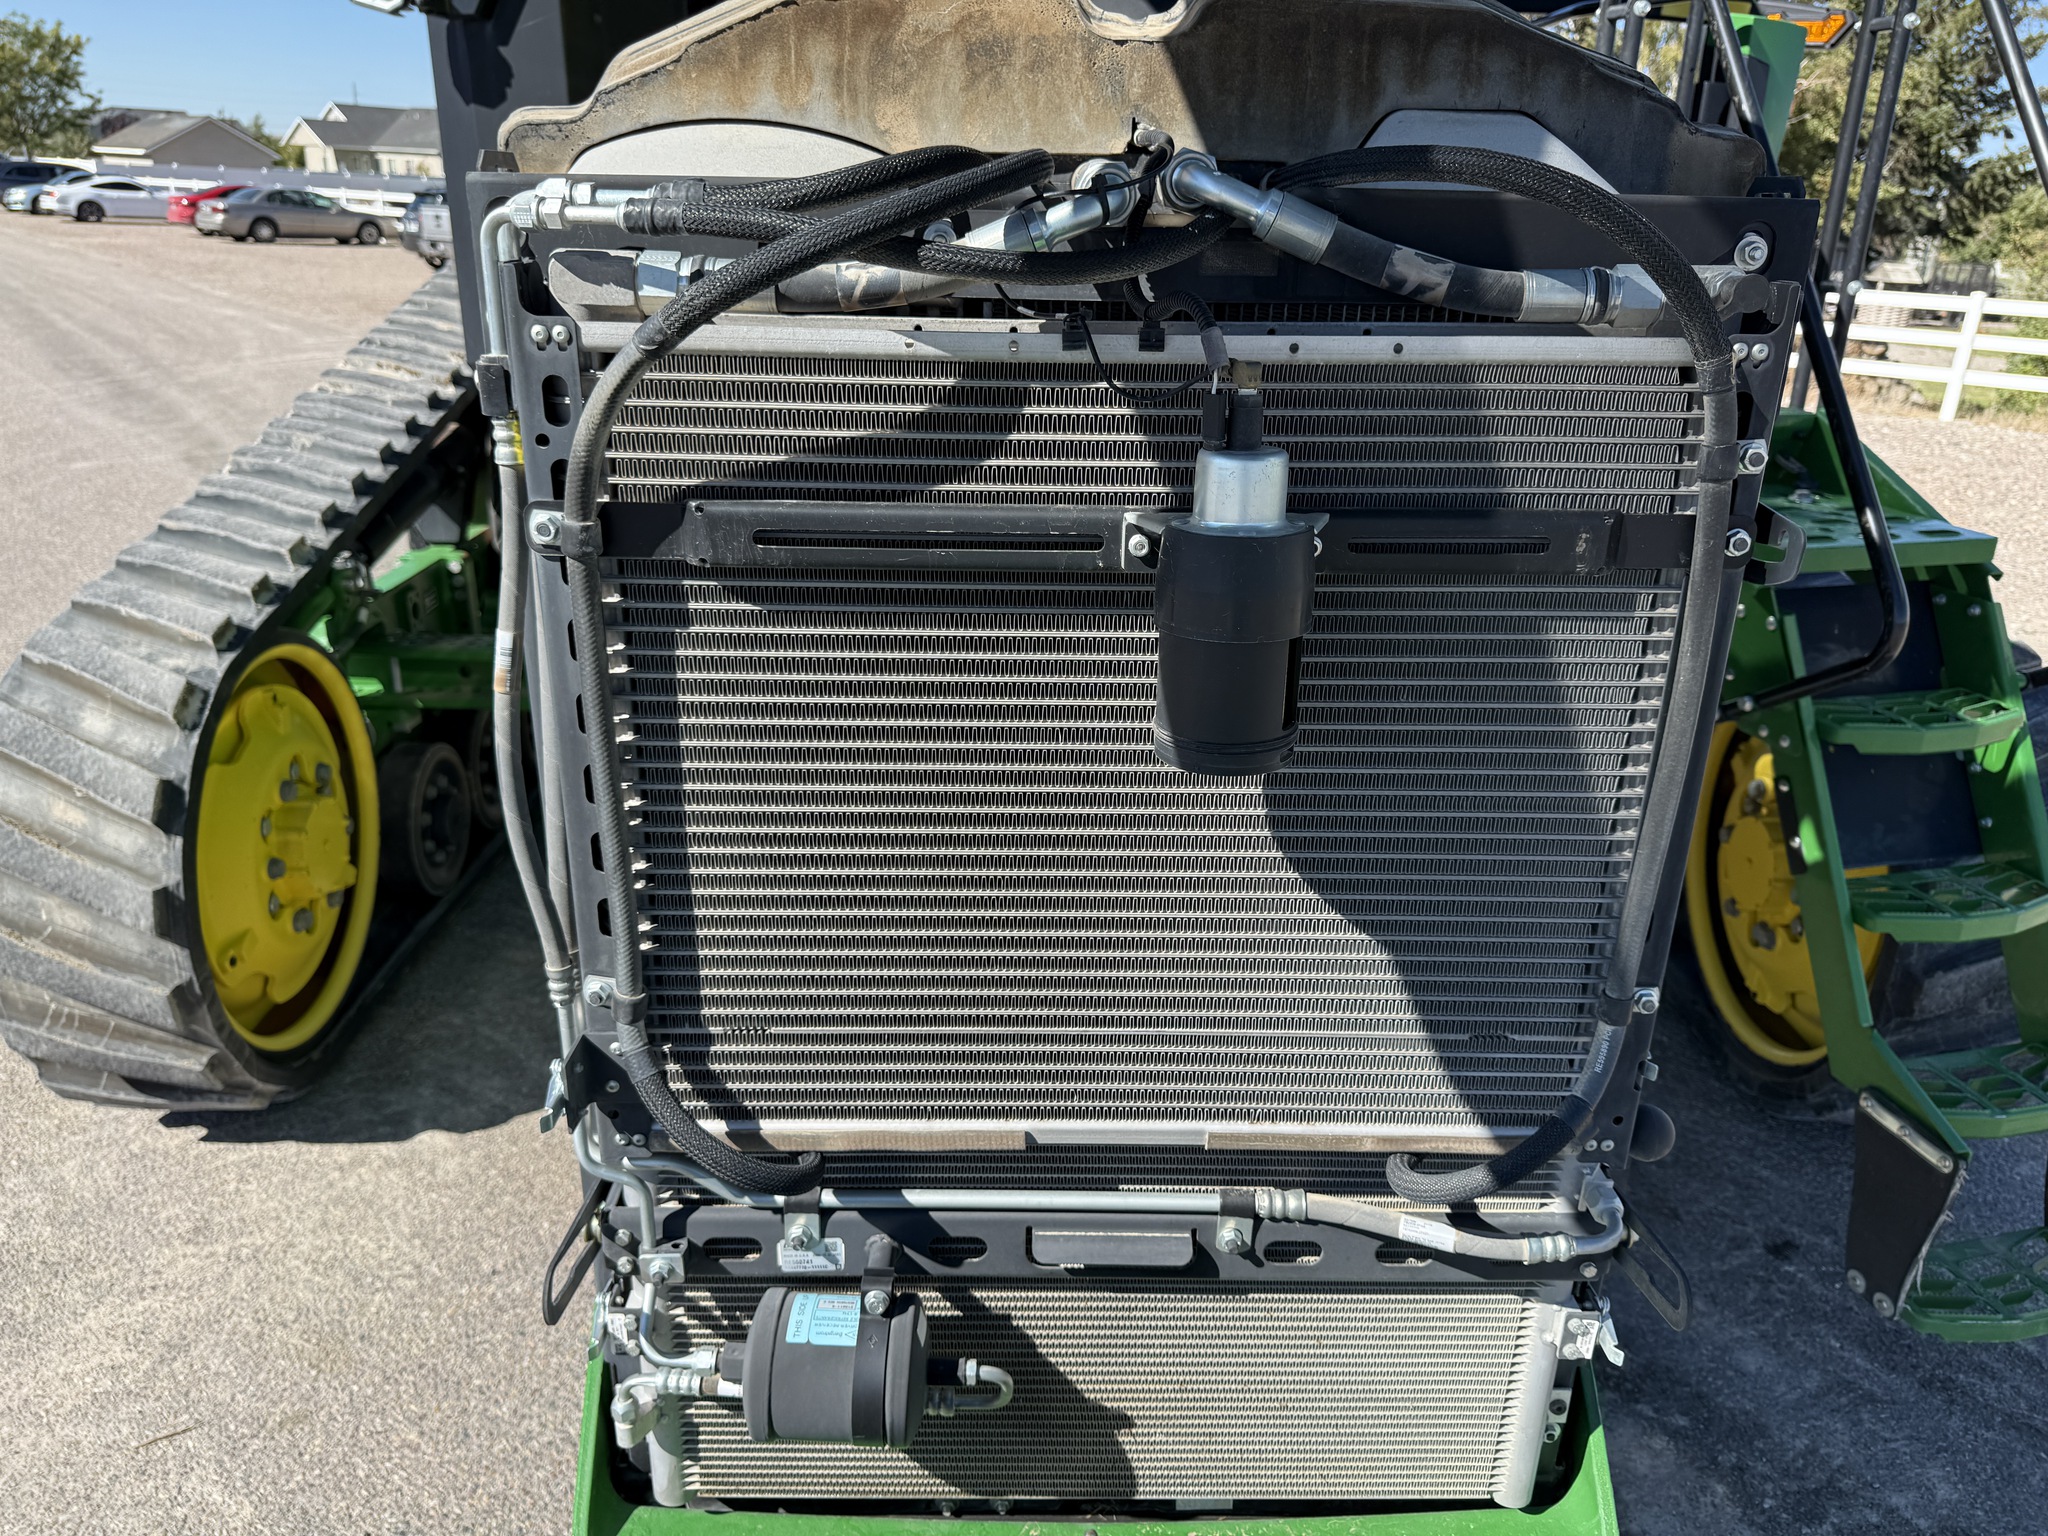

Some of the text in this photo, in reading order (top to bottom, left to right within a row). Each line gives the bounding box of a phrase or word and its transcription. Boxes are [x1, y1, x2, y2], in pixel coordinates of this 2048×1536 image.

[1594, 1040, 1610, 1073] RE595890
[797, 1302, 808, 1316] SIDE
[792, 1320, 803, 1338] THIS
[815, 1330, 843, 1338] Bergstrom
